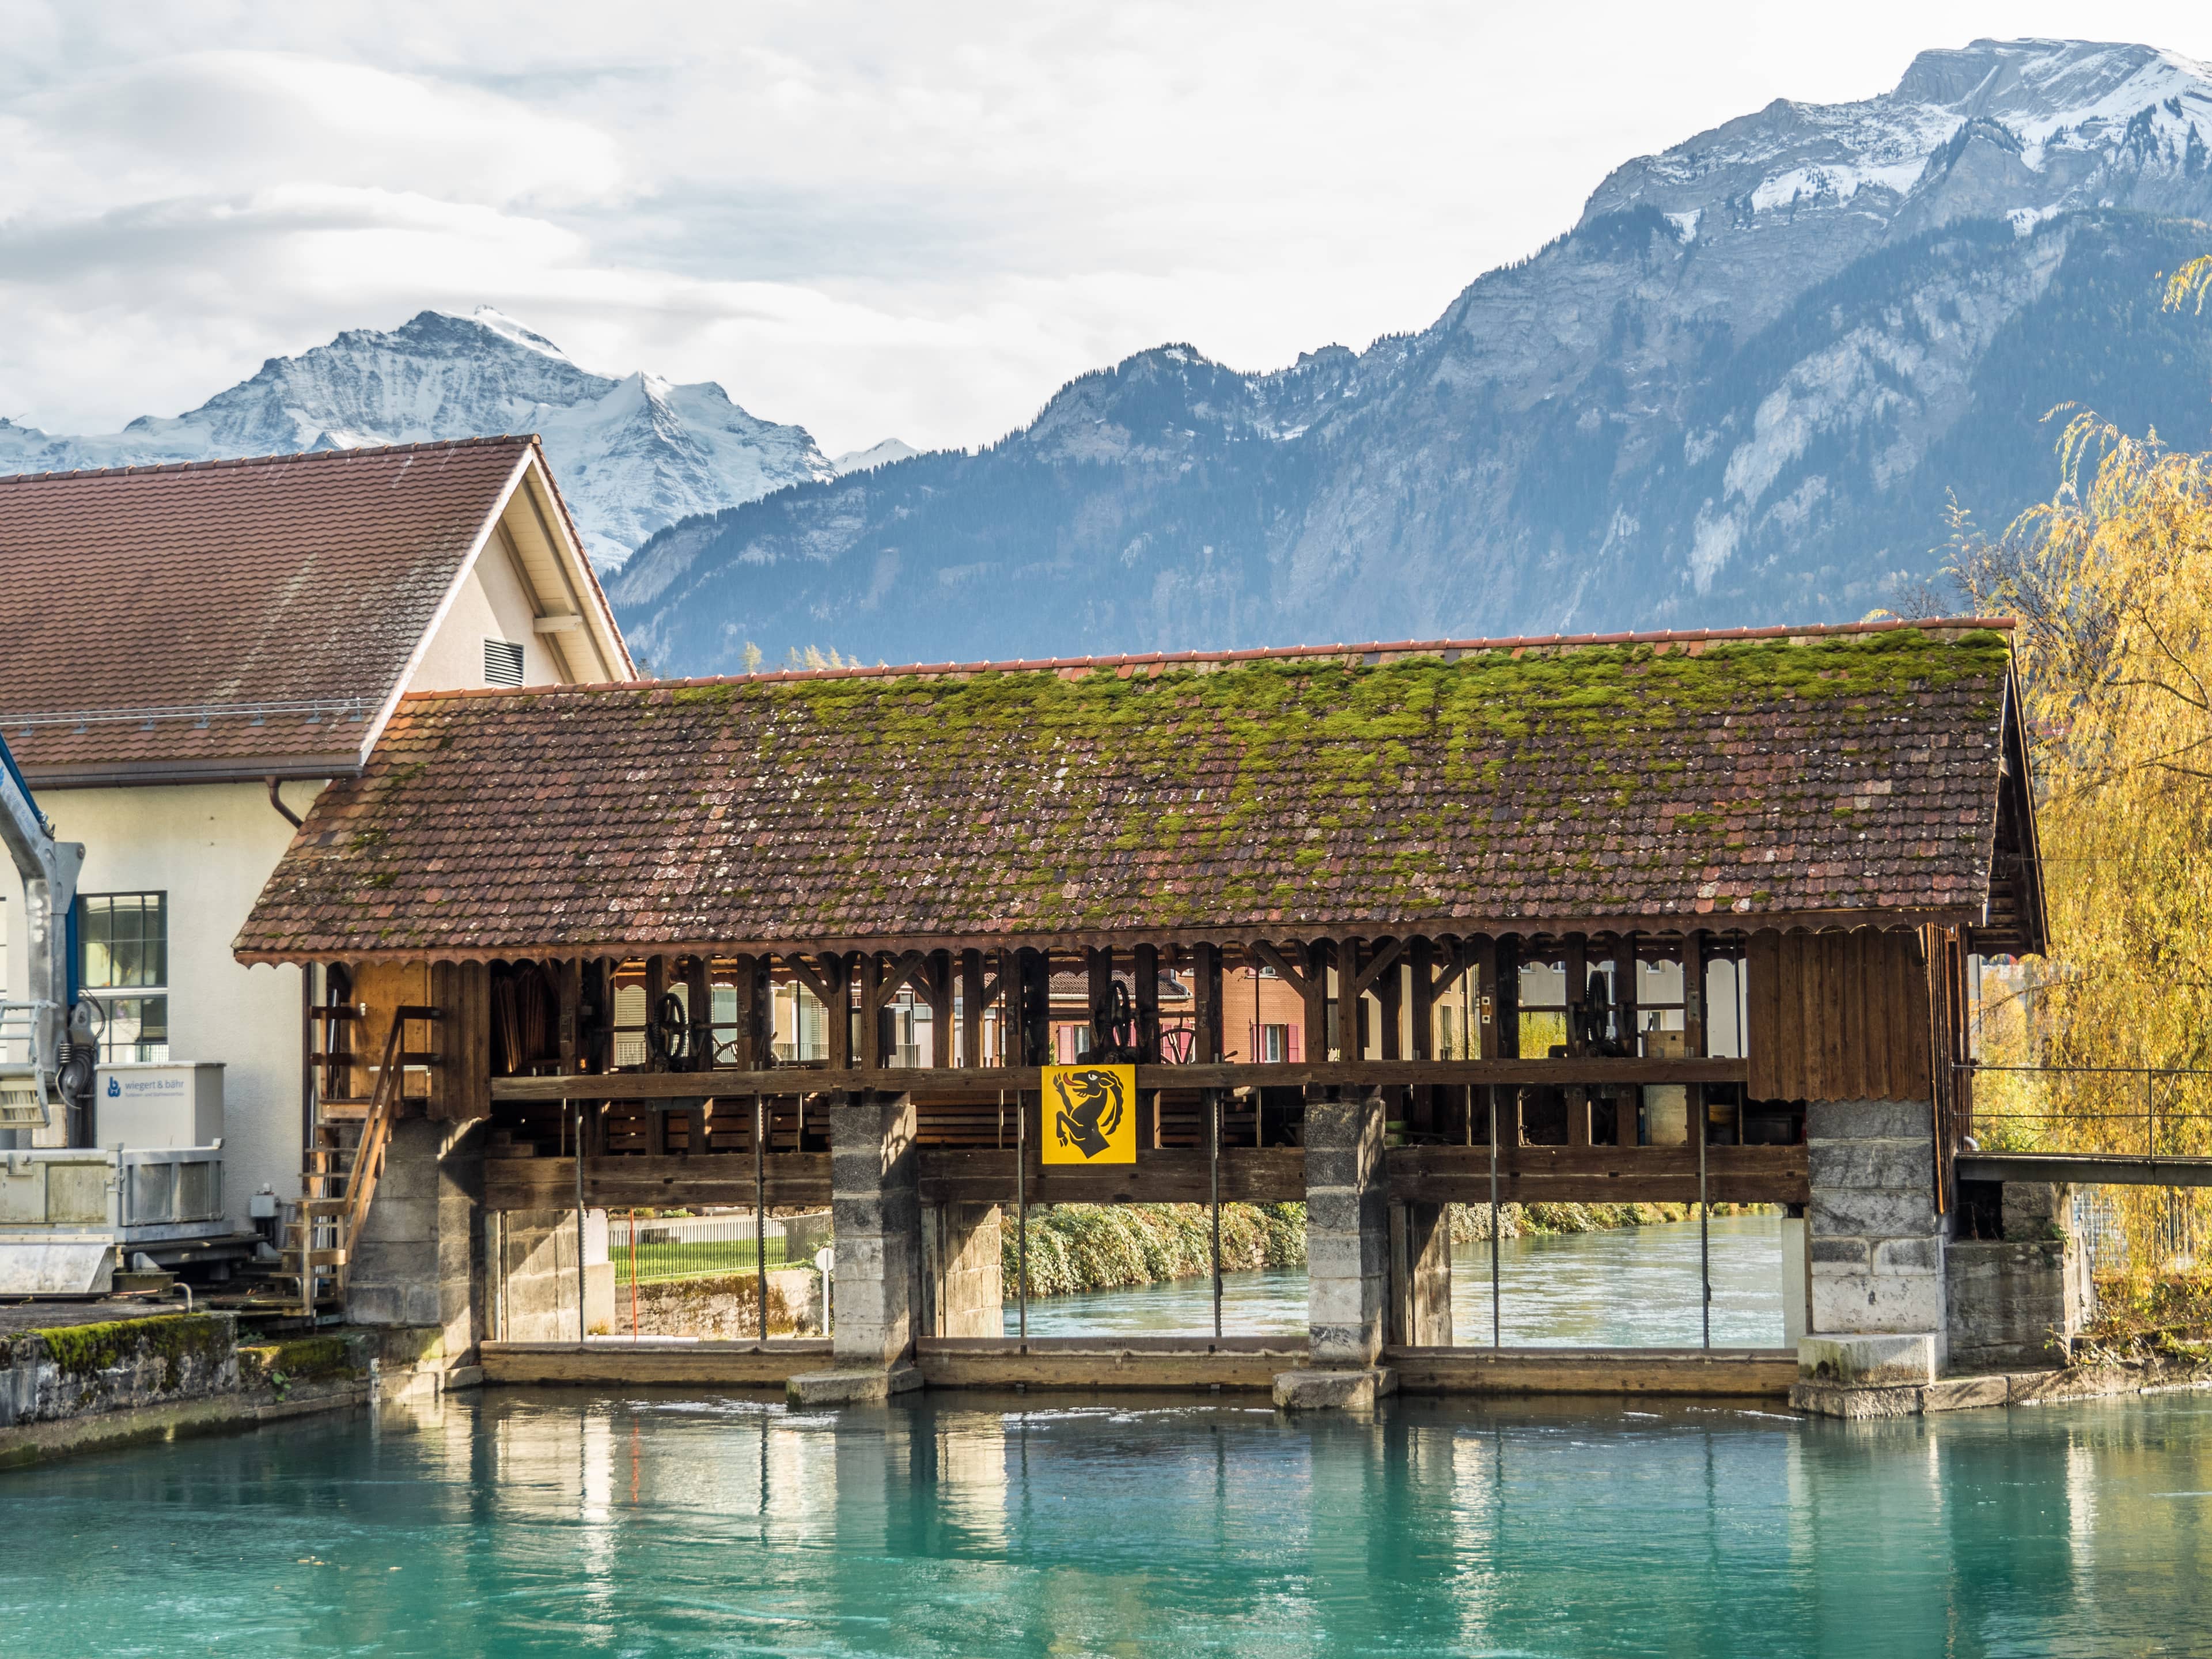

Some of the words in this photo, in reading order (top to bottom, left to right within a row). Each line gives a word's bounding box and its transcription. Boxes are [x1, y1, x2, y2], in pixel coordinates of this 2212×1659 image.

[125, 1081, 156, 1091] wiegert
[157, 1081, 163, 1089] &
[165, 1079, 184, 1088] bähr
